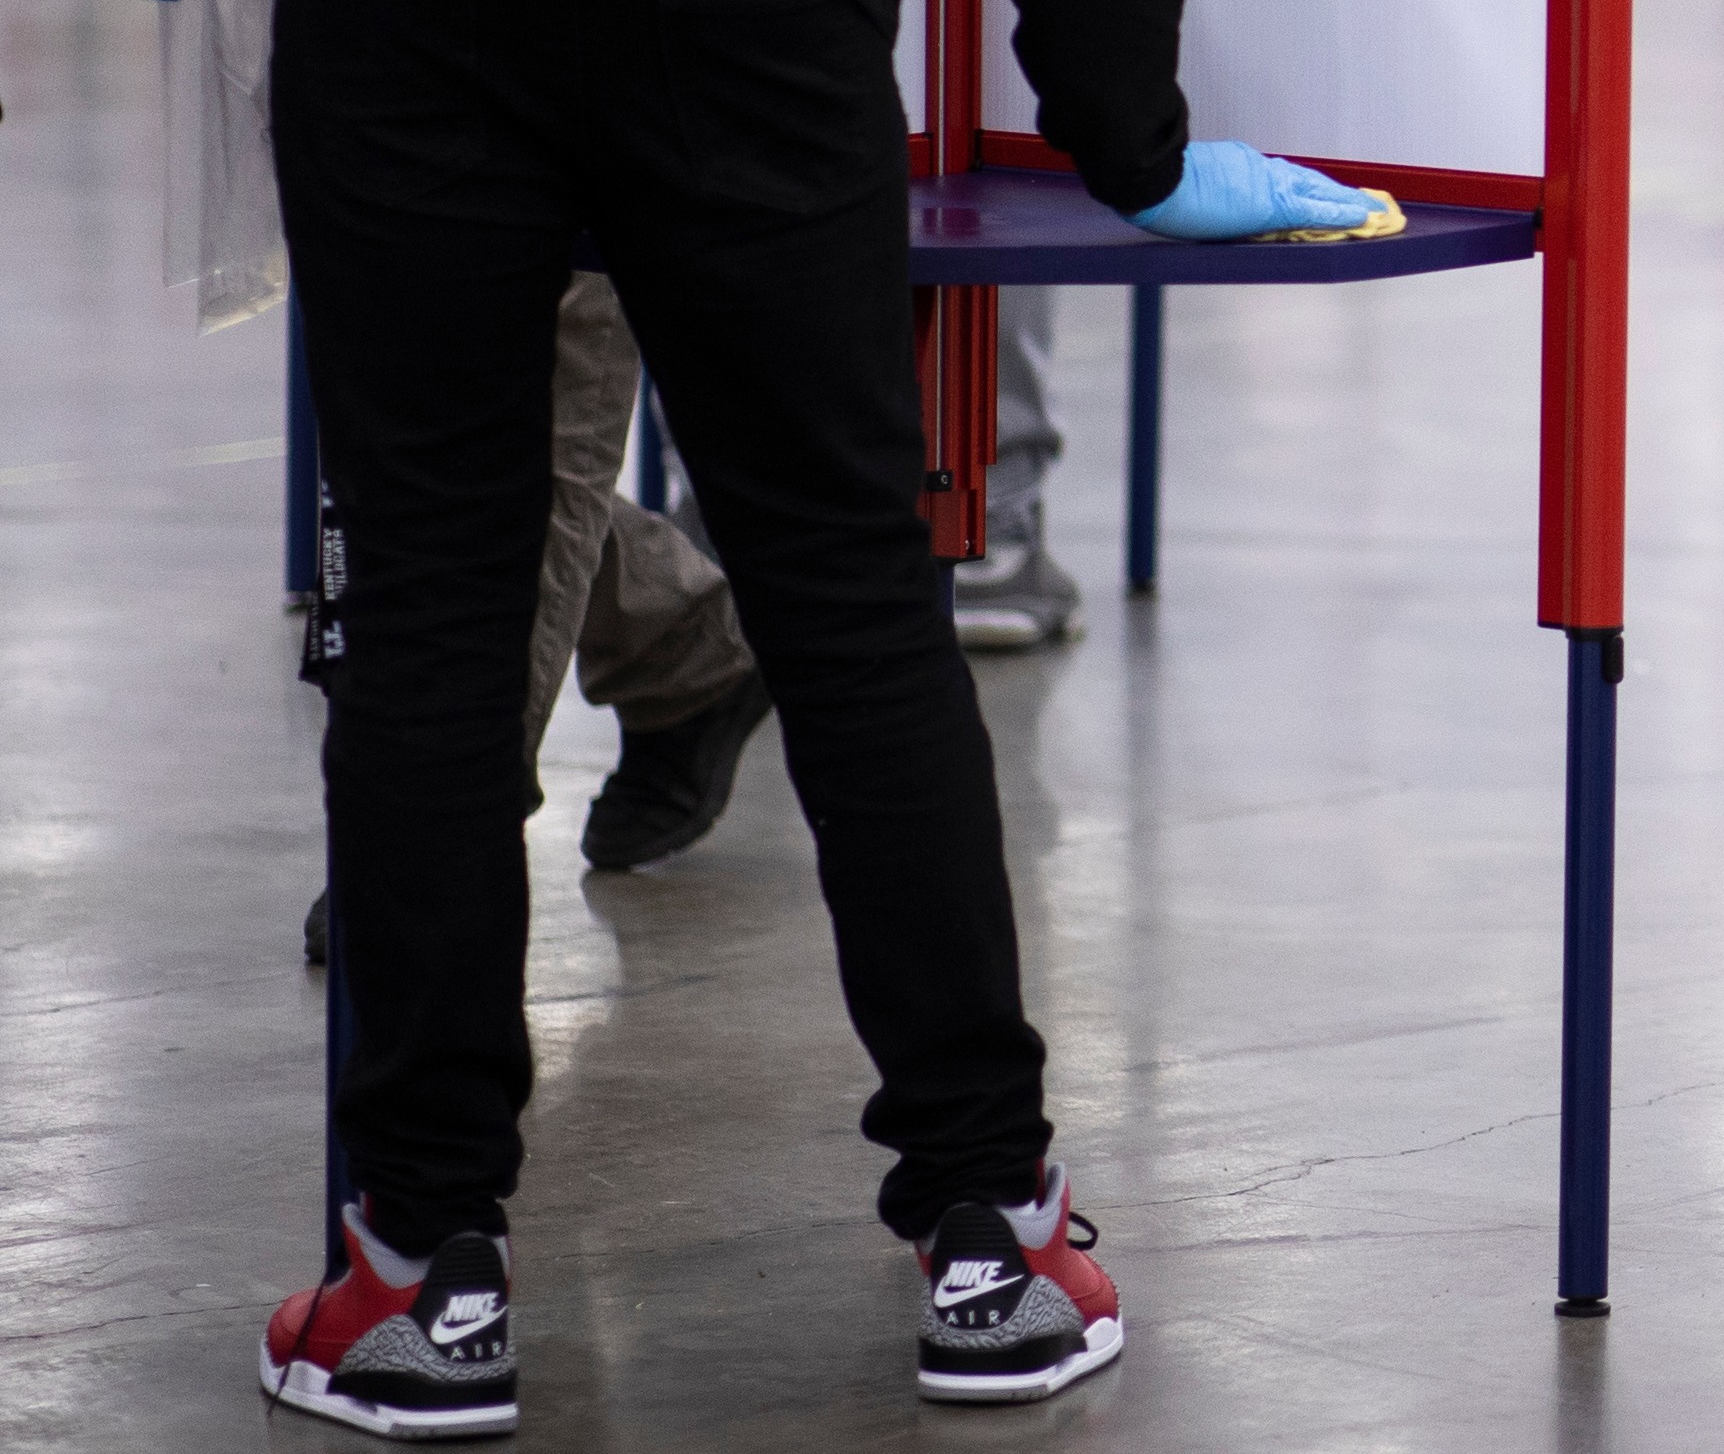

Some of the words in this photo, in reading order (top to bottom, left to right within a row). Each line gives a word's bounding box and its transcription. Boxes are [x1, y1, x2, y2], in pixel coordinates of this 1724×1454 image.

[323, 528, 335, 600] KENTUCKY
[944, 1261, 1003, 1287] NIKE
[444, 1292, 499, 1322] NIKE
[946, 1310, 999, 1326] AIR
[451, 1342, 501, 1361] AIR
